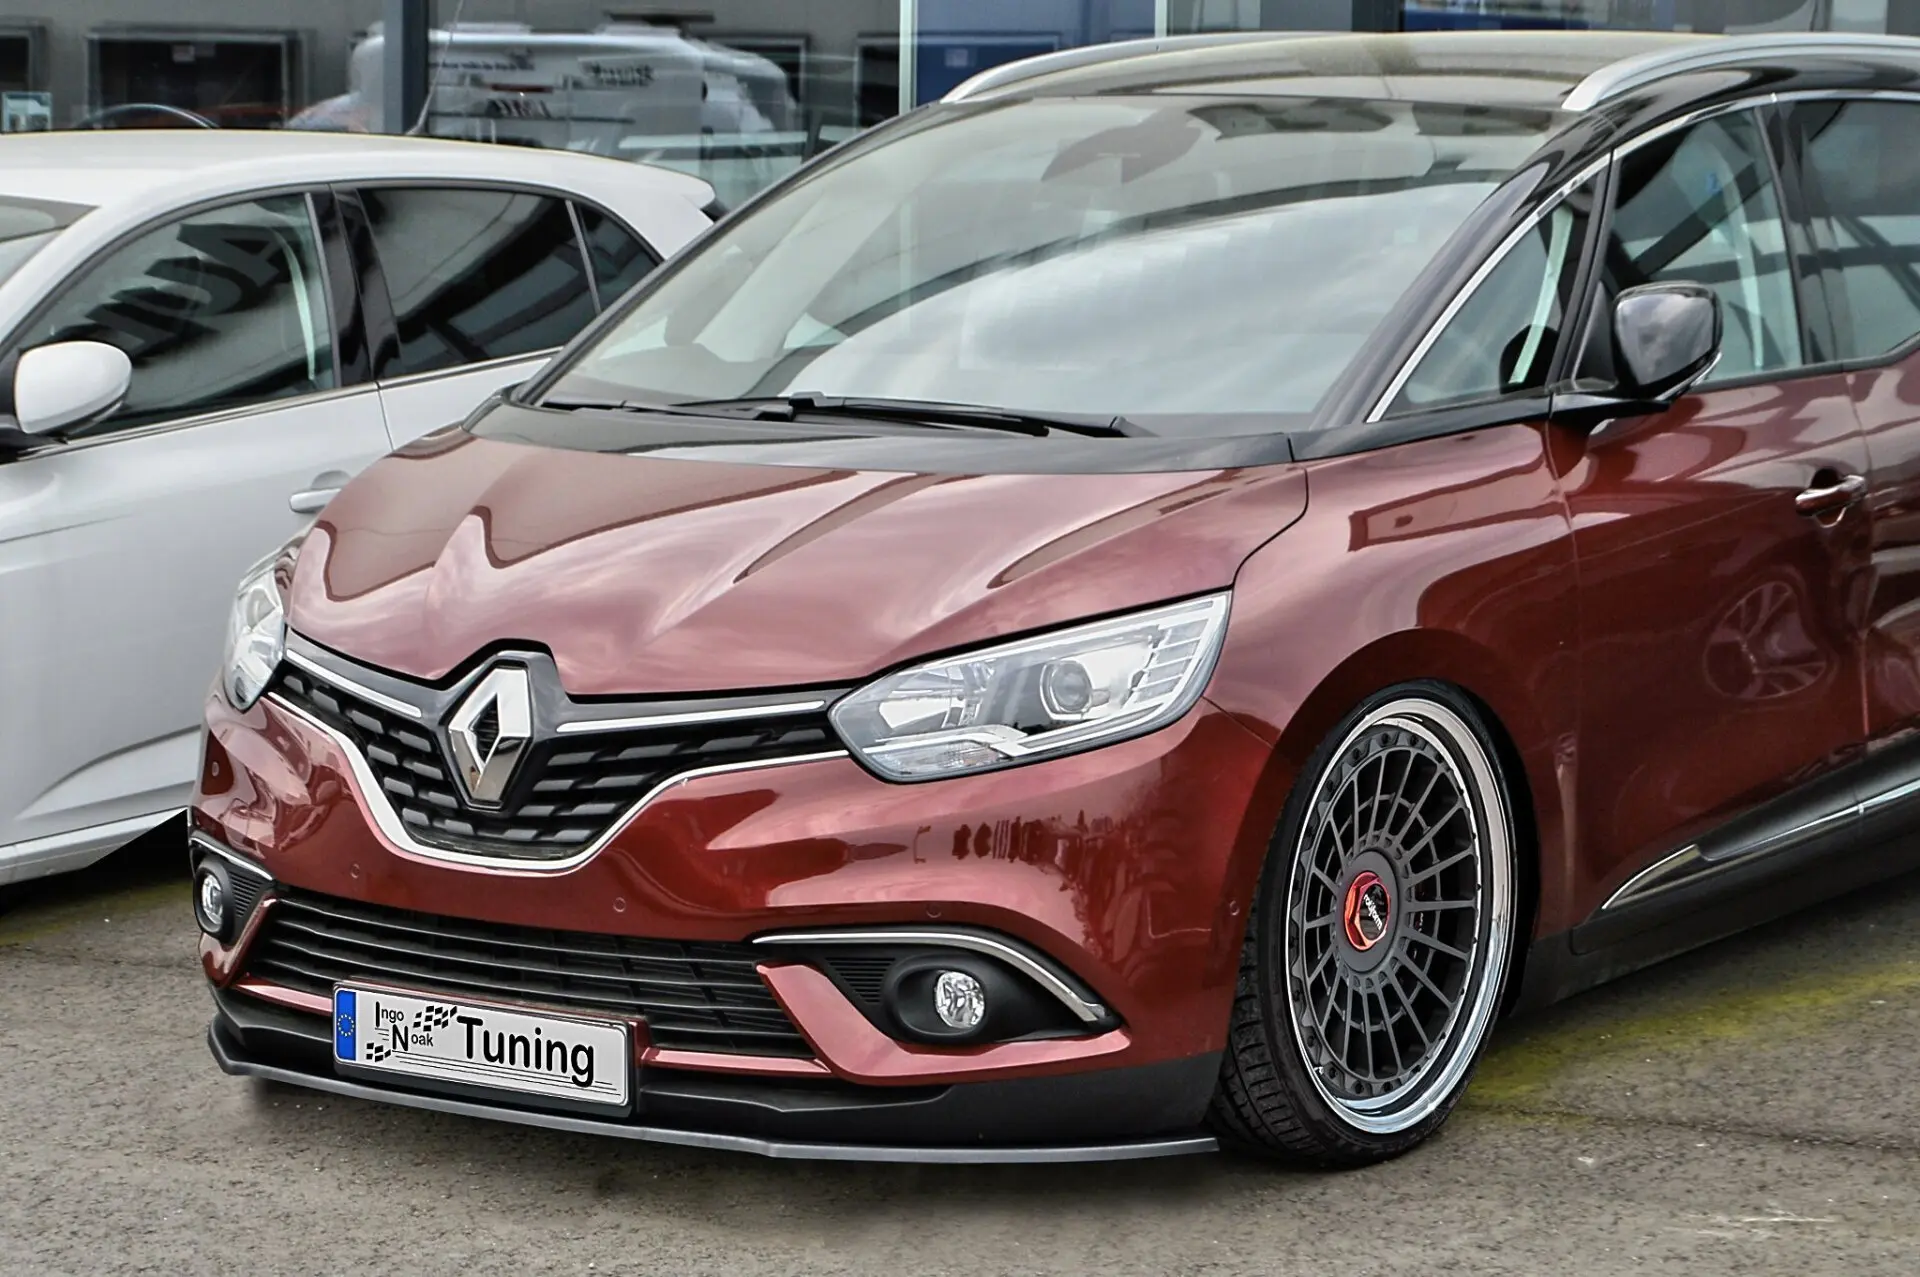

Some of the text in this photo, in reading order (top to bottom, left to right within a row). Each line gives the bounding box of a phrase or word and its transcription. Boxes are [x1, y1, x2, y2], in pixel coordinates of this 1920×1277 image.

[375, 1001, 405, 1028] Ingo
[391, 1024, 434, 1051] Noak
[456, 1015, 594, 1087] Tuning
